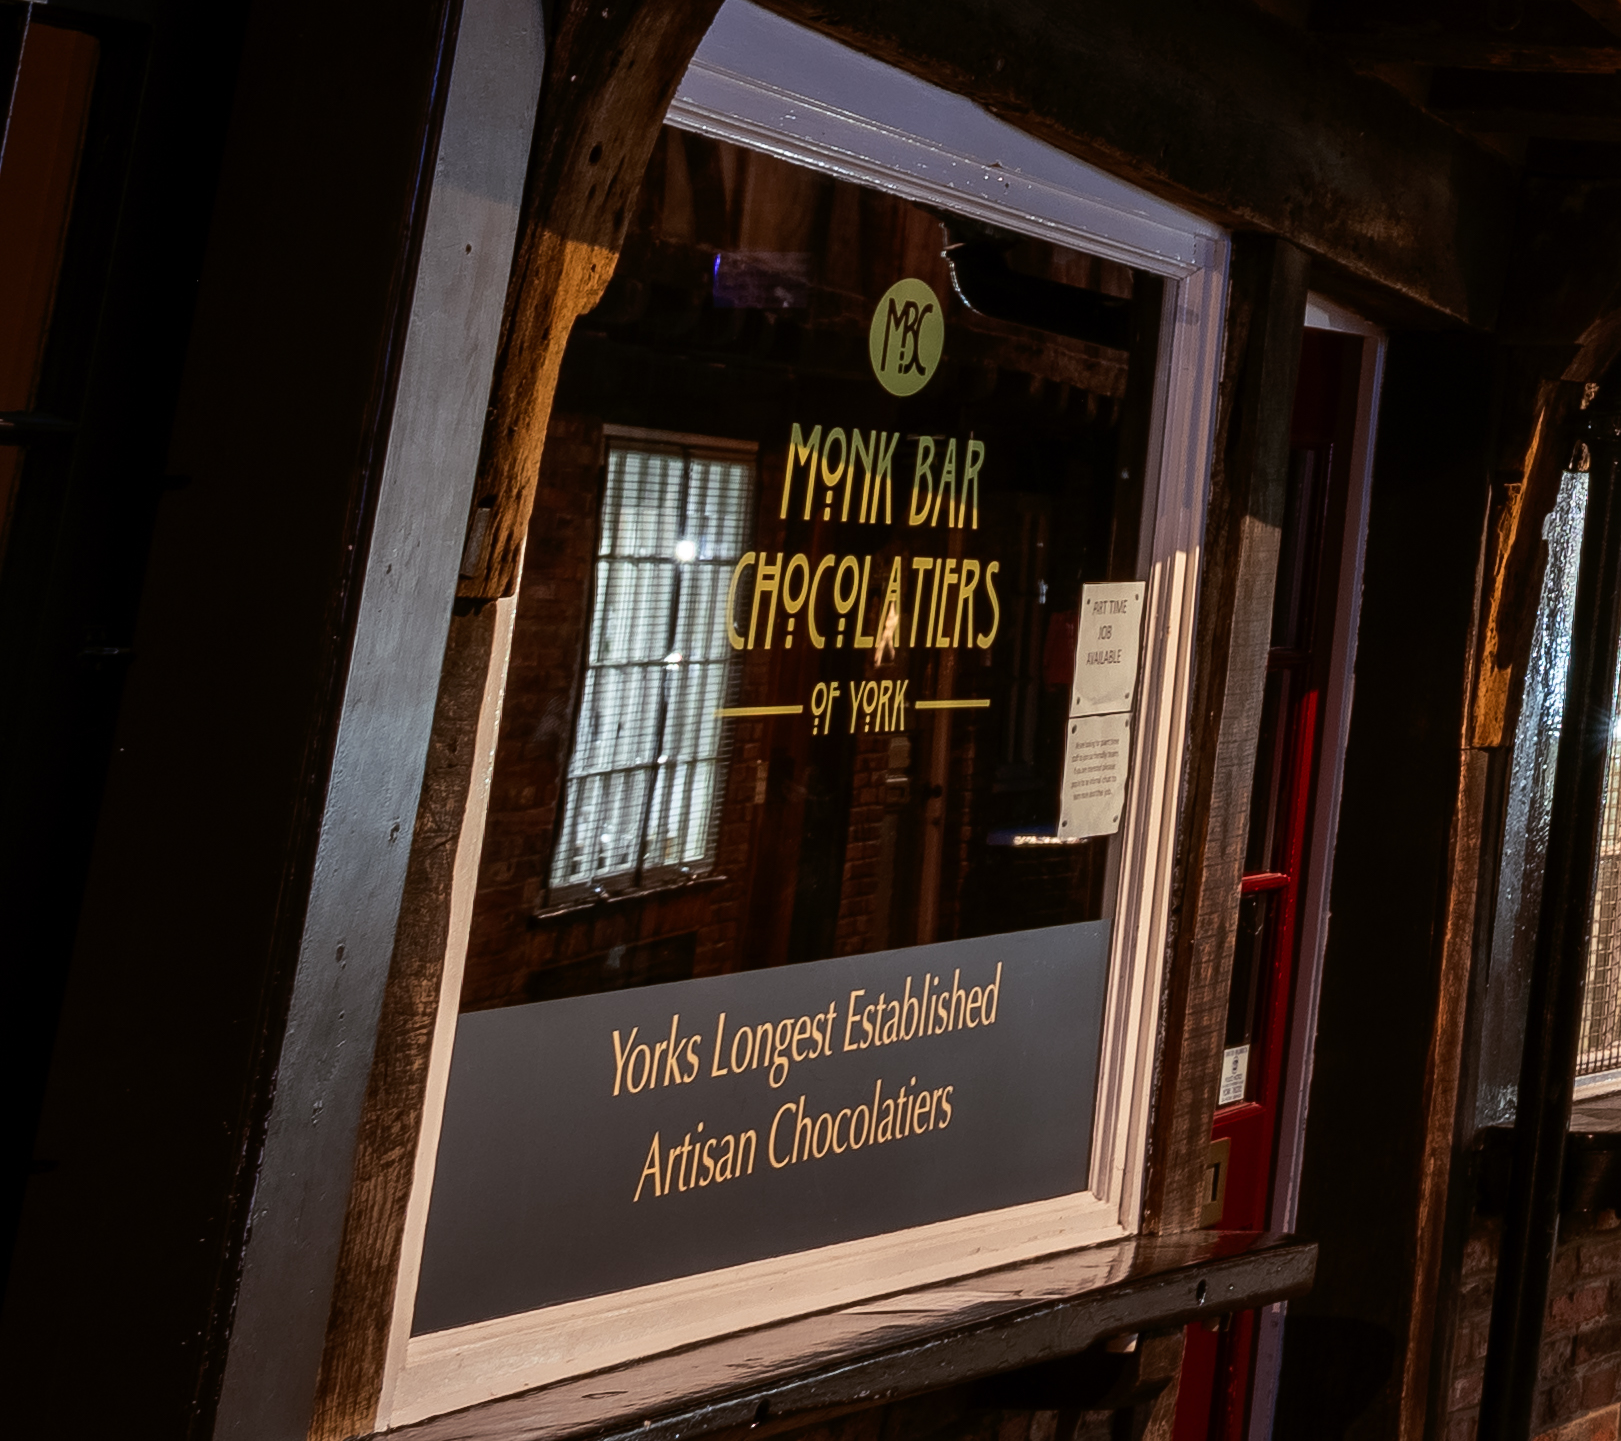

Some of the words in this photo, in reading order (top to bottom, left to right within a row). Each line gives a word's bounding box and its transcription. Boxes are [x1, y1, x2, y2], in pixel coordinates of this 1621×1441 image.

[880, 297, 934, 376] MBC
[779, 421, 901, 526] MONK
[908, 435, 985, 530] BAR
[726, 551, 1001, 650] CHOCOLATIERS
[1097, 625, 1113, 641] JOB
[1085, 648, 1122, 666] AVAILABLE
[811, 680, 841, 736] OF
[850, 679, 910, 735] YORK
[612, 1013, 702, 1097] Yorks
[710, 1000, 838, 1089] Longest
[843, 961, 1003, 1052] Established
[633, 1121, 757, 1203] Artisan
[768, 1076, 955, 1170] Chocolatiers
